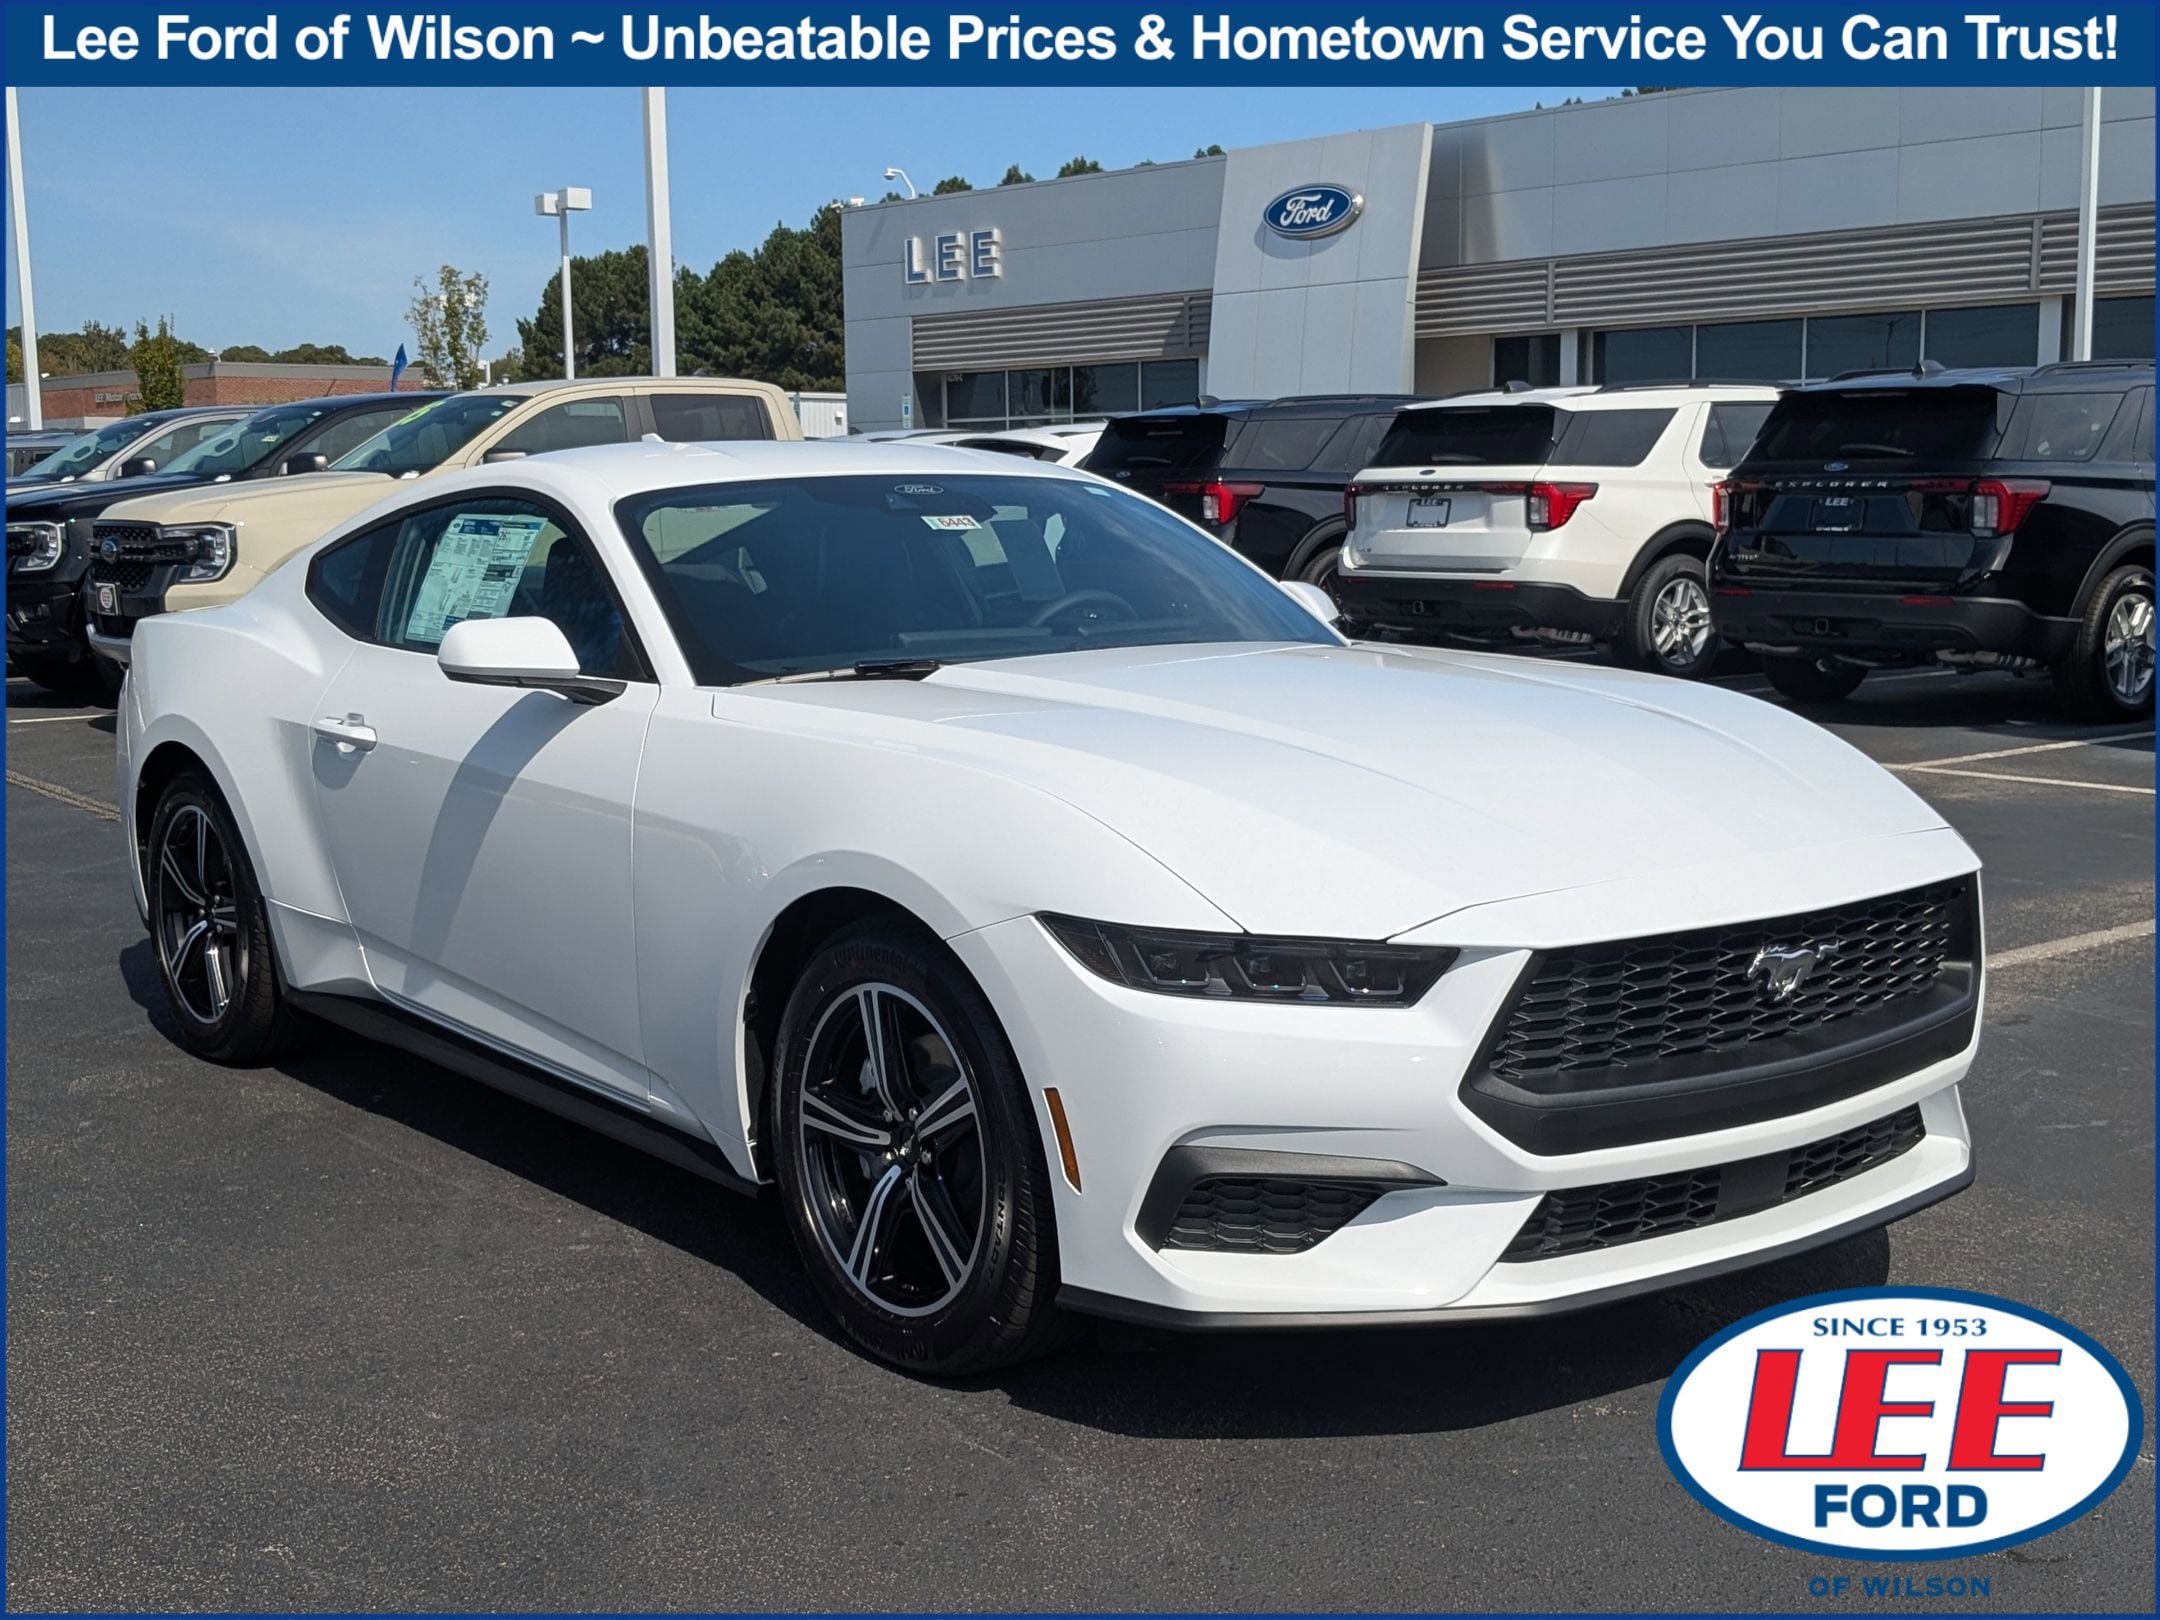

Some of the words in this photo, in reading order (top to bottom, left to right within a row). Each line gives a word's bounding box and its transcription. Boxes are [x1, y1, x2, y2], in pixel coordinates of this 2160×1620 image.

[1280, 194, 1335, 227] Ford
[904, 228, 1002, 284] LEE
[904, 485, 936, 493] Ford
[1825, 497, 1849, 506] LEE
[937, 517, 976, 527] 6443
